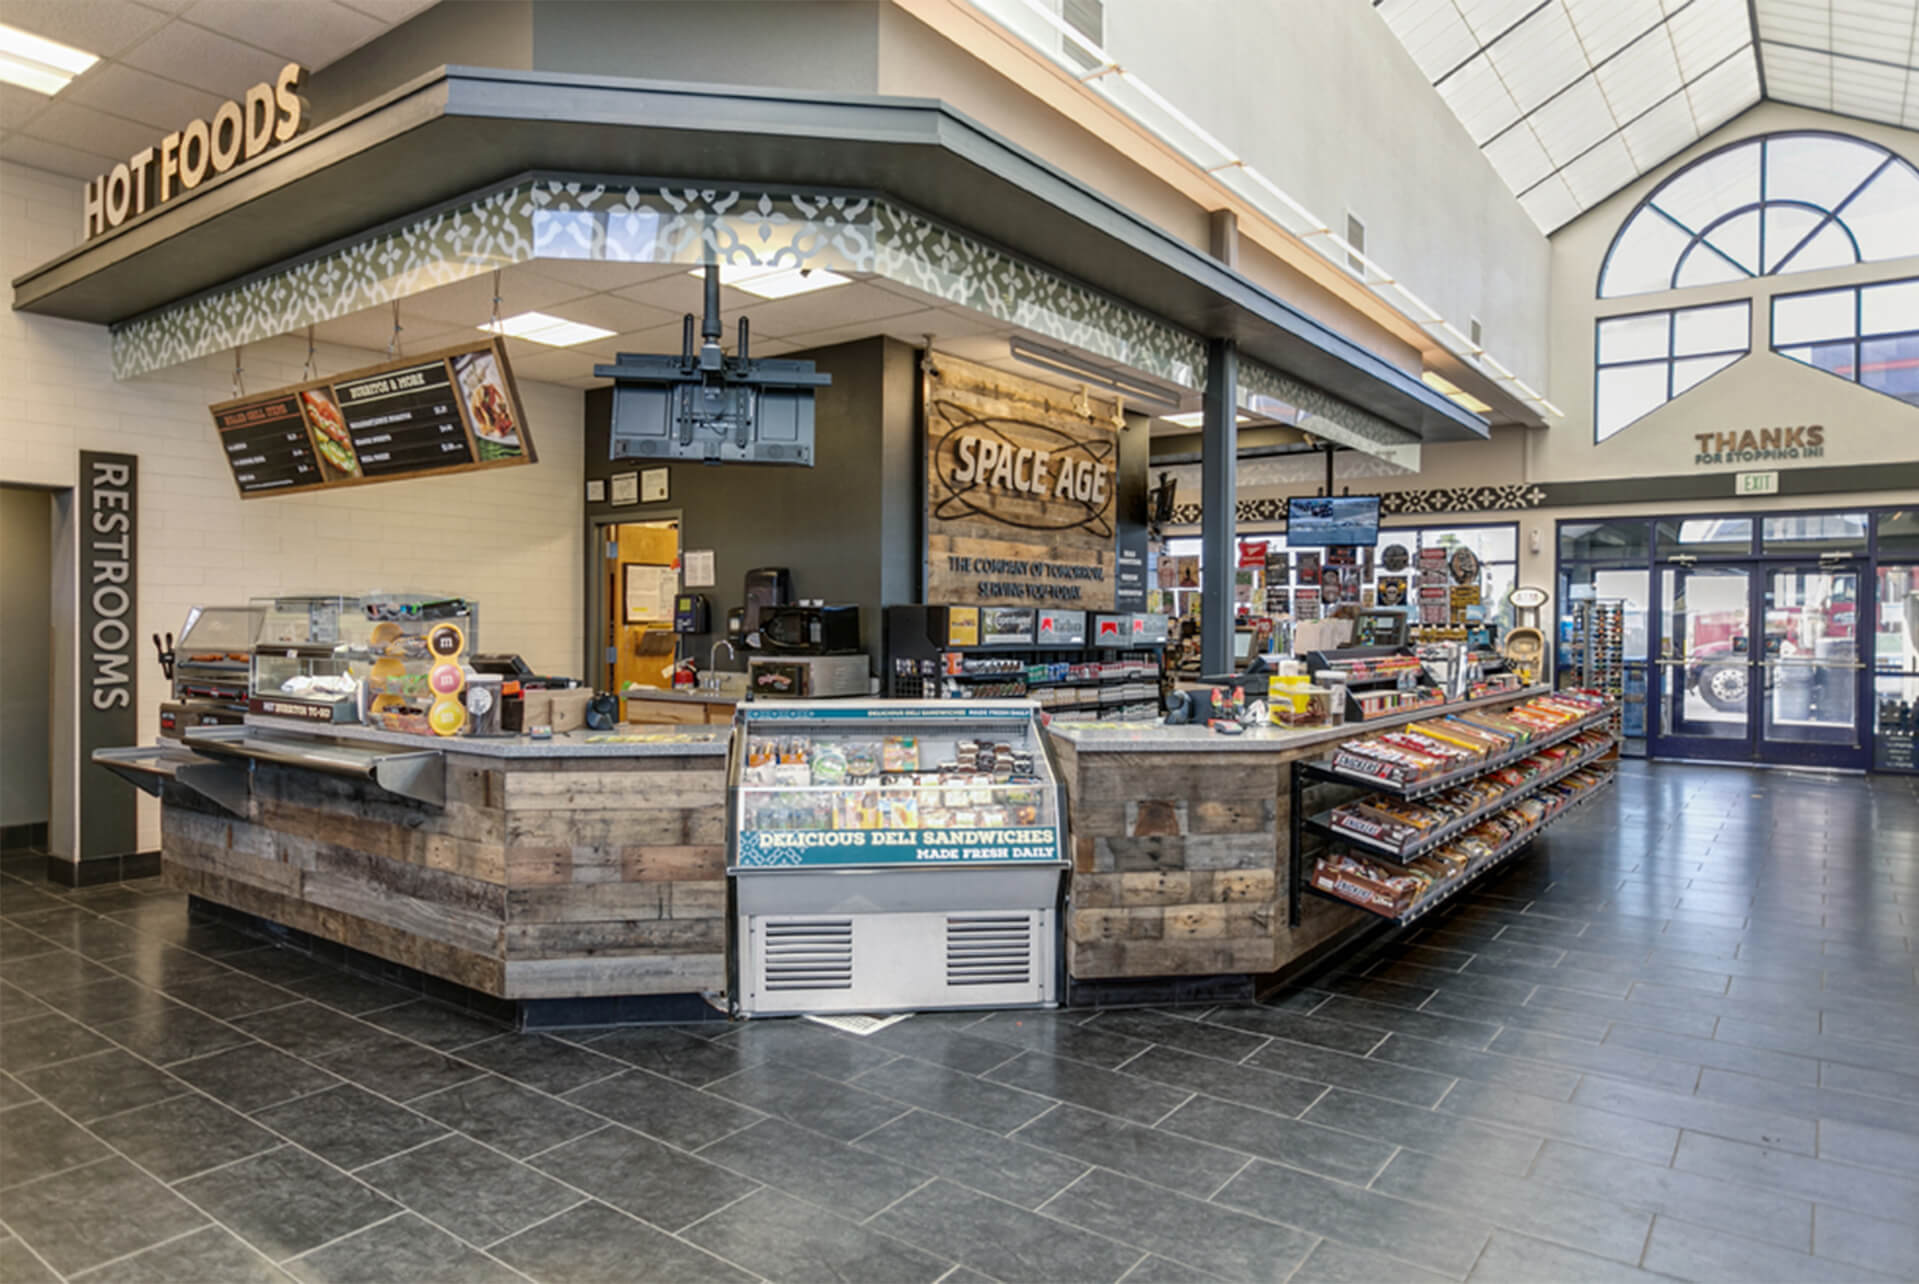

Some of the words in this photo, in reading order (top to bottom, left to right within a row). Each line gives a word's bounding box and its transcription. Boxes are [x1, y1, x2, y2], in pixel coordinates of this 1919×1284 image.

[84, 147, 154, 241] HOT
[160, 63, 303, 202] FOODS
[1695, 425, 1824, 454] THANKS
[1695, 453, 1723, 465] FOR
[1726, 448, 1799, 463] STOPPING
[955, 435, 1050, 494] SPACE
[1055, 456, 1109, 503] AGE
[1744, 475, 1771, 492] EXIT
[948, 556, 972, 572] THE
[974, 558, 1028, 576] COMPANY
[1030, 560, 1044, 577] OF
[92, 462, 130, 711] RESTROOMS
[978, 581, 1025, 599] SERVING
[1025, 583, 1045, 599] YOU
[440, 638, 453, 648] m
[440, 675, 453, 686] m
[1339, 754, 1379, 774] SNICKERS
[759, 832, 866, 848] DELICIOUS
[871, 831, 917, 845] DELI
[923, 829, 1055, 845] SANDWICHES
[917, 848, 959, 860] MADE
[962, 847, 1009, 859] FRESH
[1012, 846, 1055, 858] DAILY
